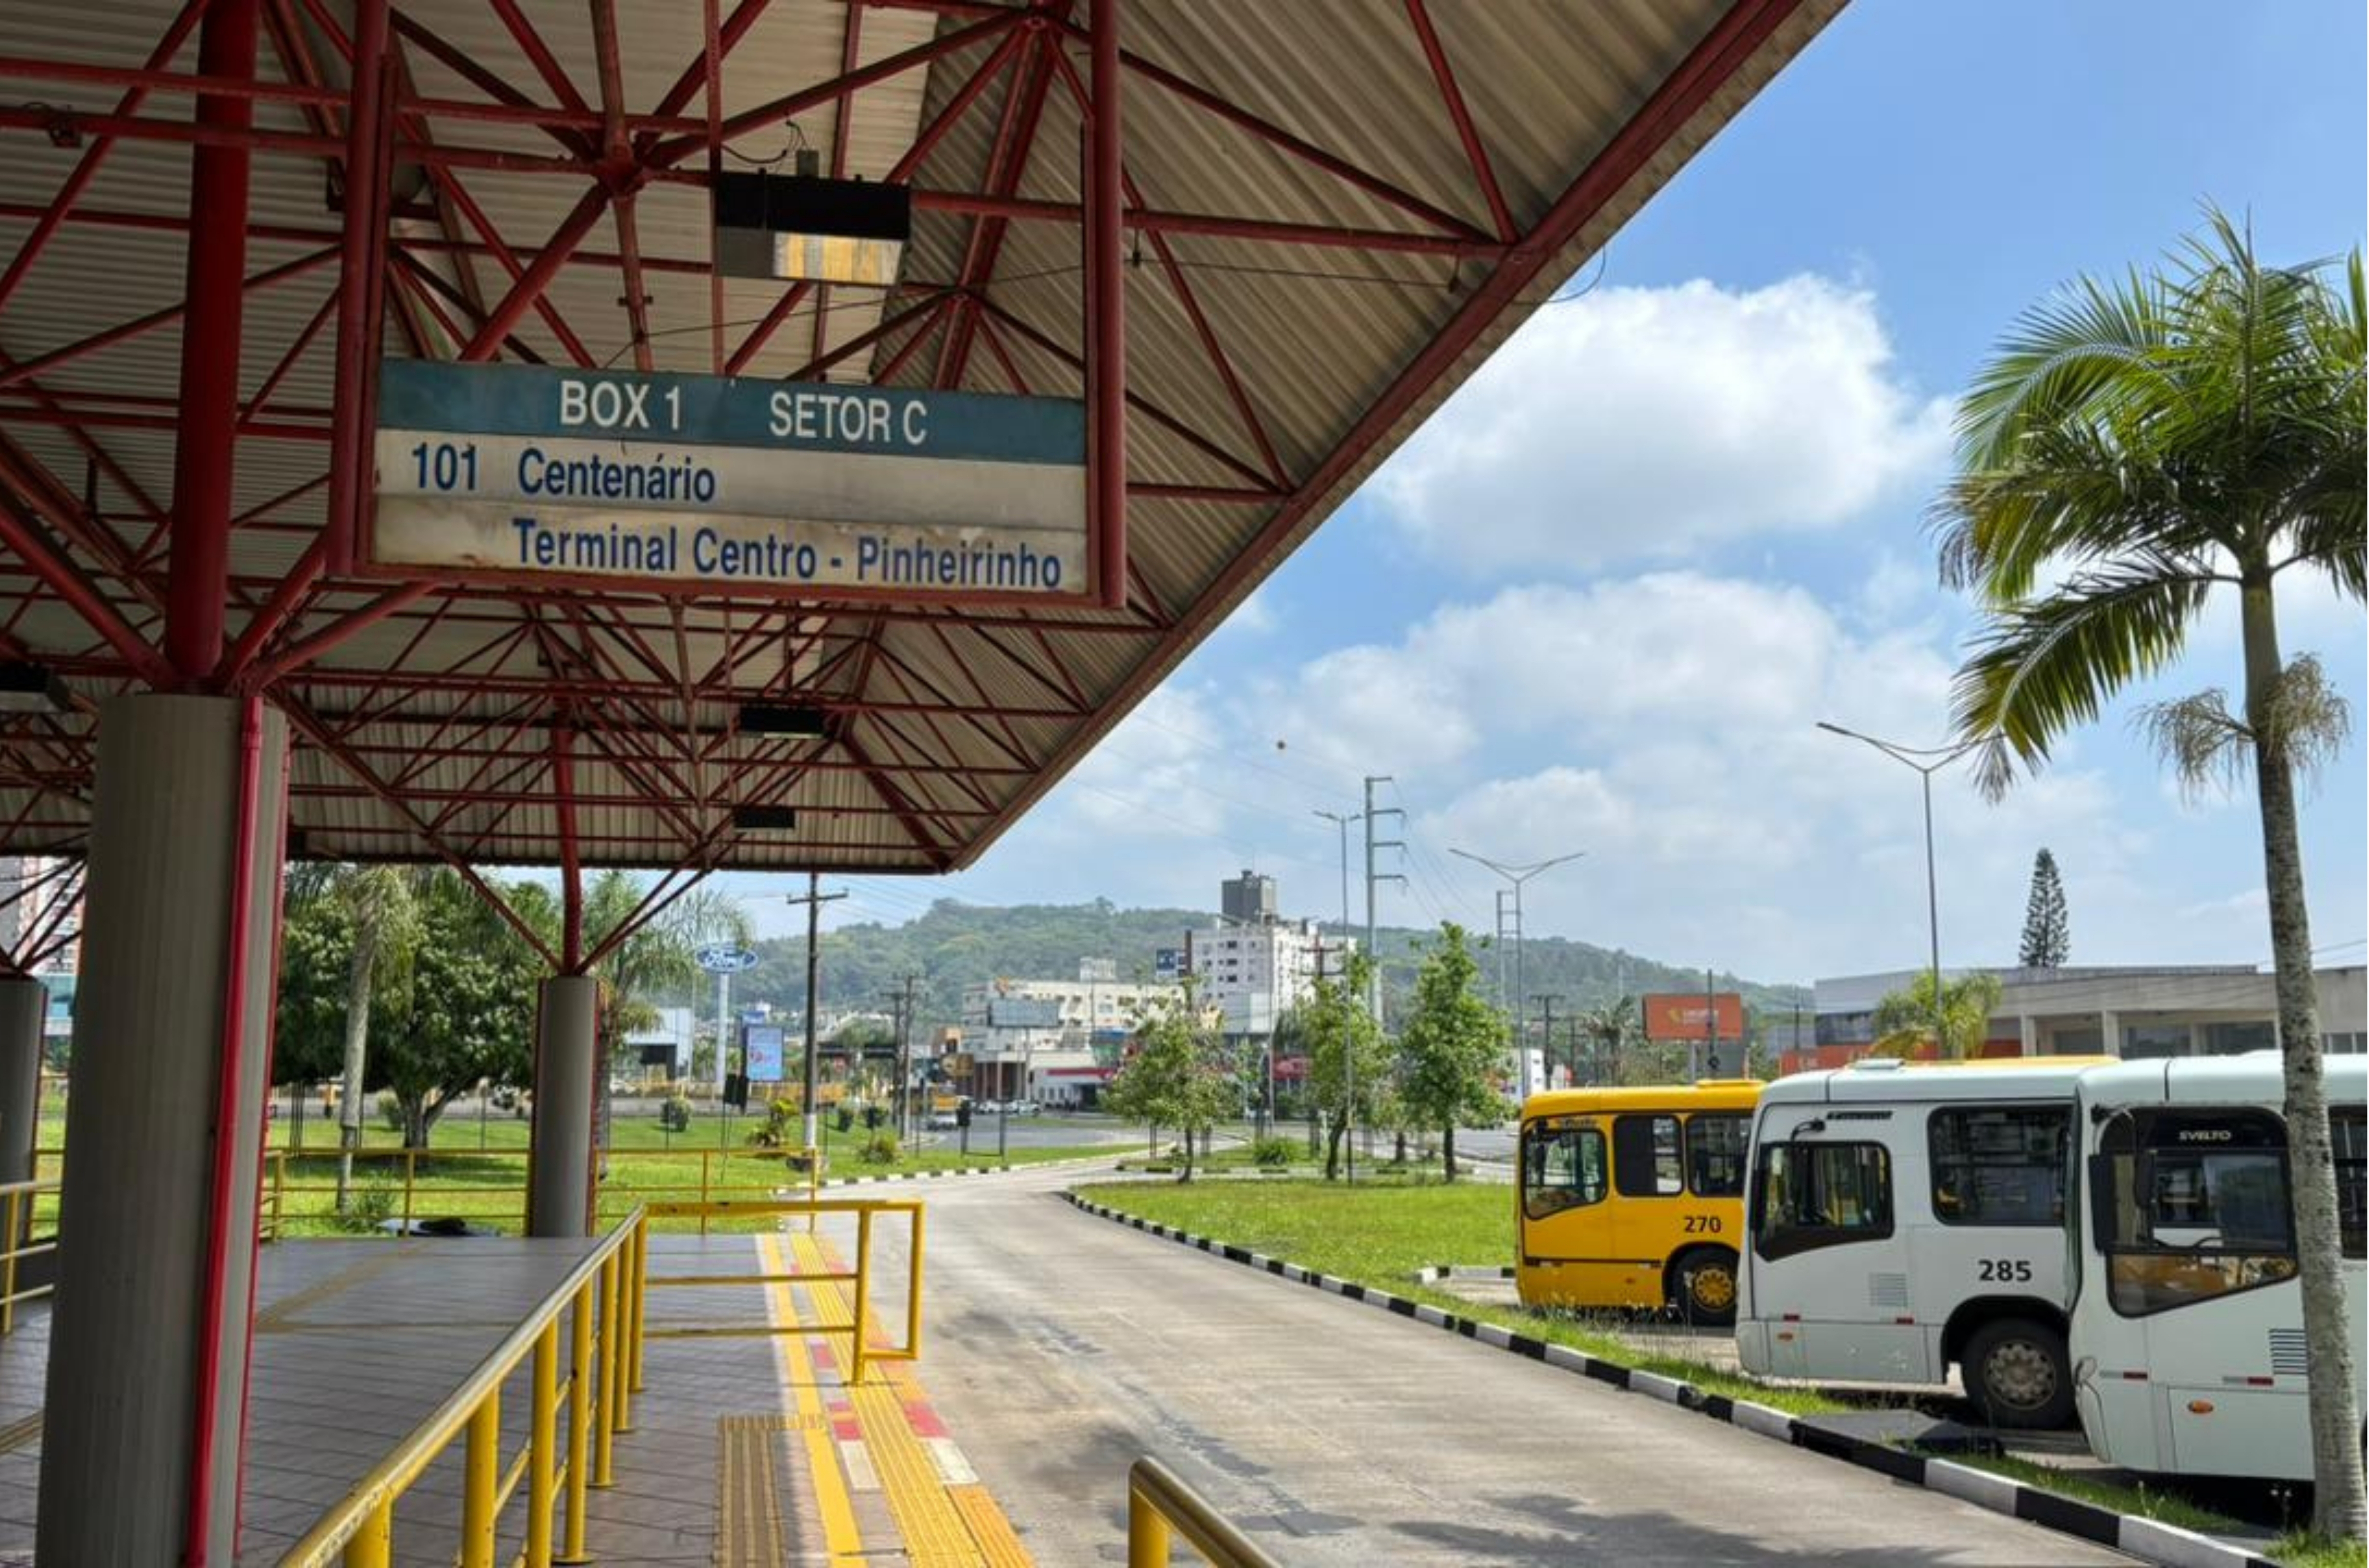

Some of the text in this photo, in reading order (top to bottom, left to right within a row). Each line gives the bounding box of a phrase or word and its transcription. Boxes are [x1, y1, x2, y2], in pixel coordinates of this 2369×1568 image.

[560, 380, 927, 445] BOX 1 SETOR C
[412, 442, 715, 502] 101 Centenário
[513, 518, 677, 571] Terminal
[694, 527, 816, 578] Centro
[857, 536, 1060, 587] Pinheirinho
[1684, 1215, 1721, 1233] 270
[1979, 1259, 2032, 1281] 285
